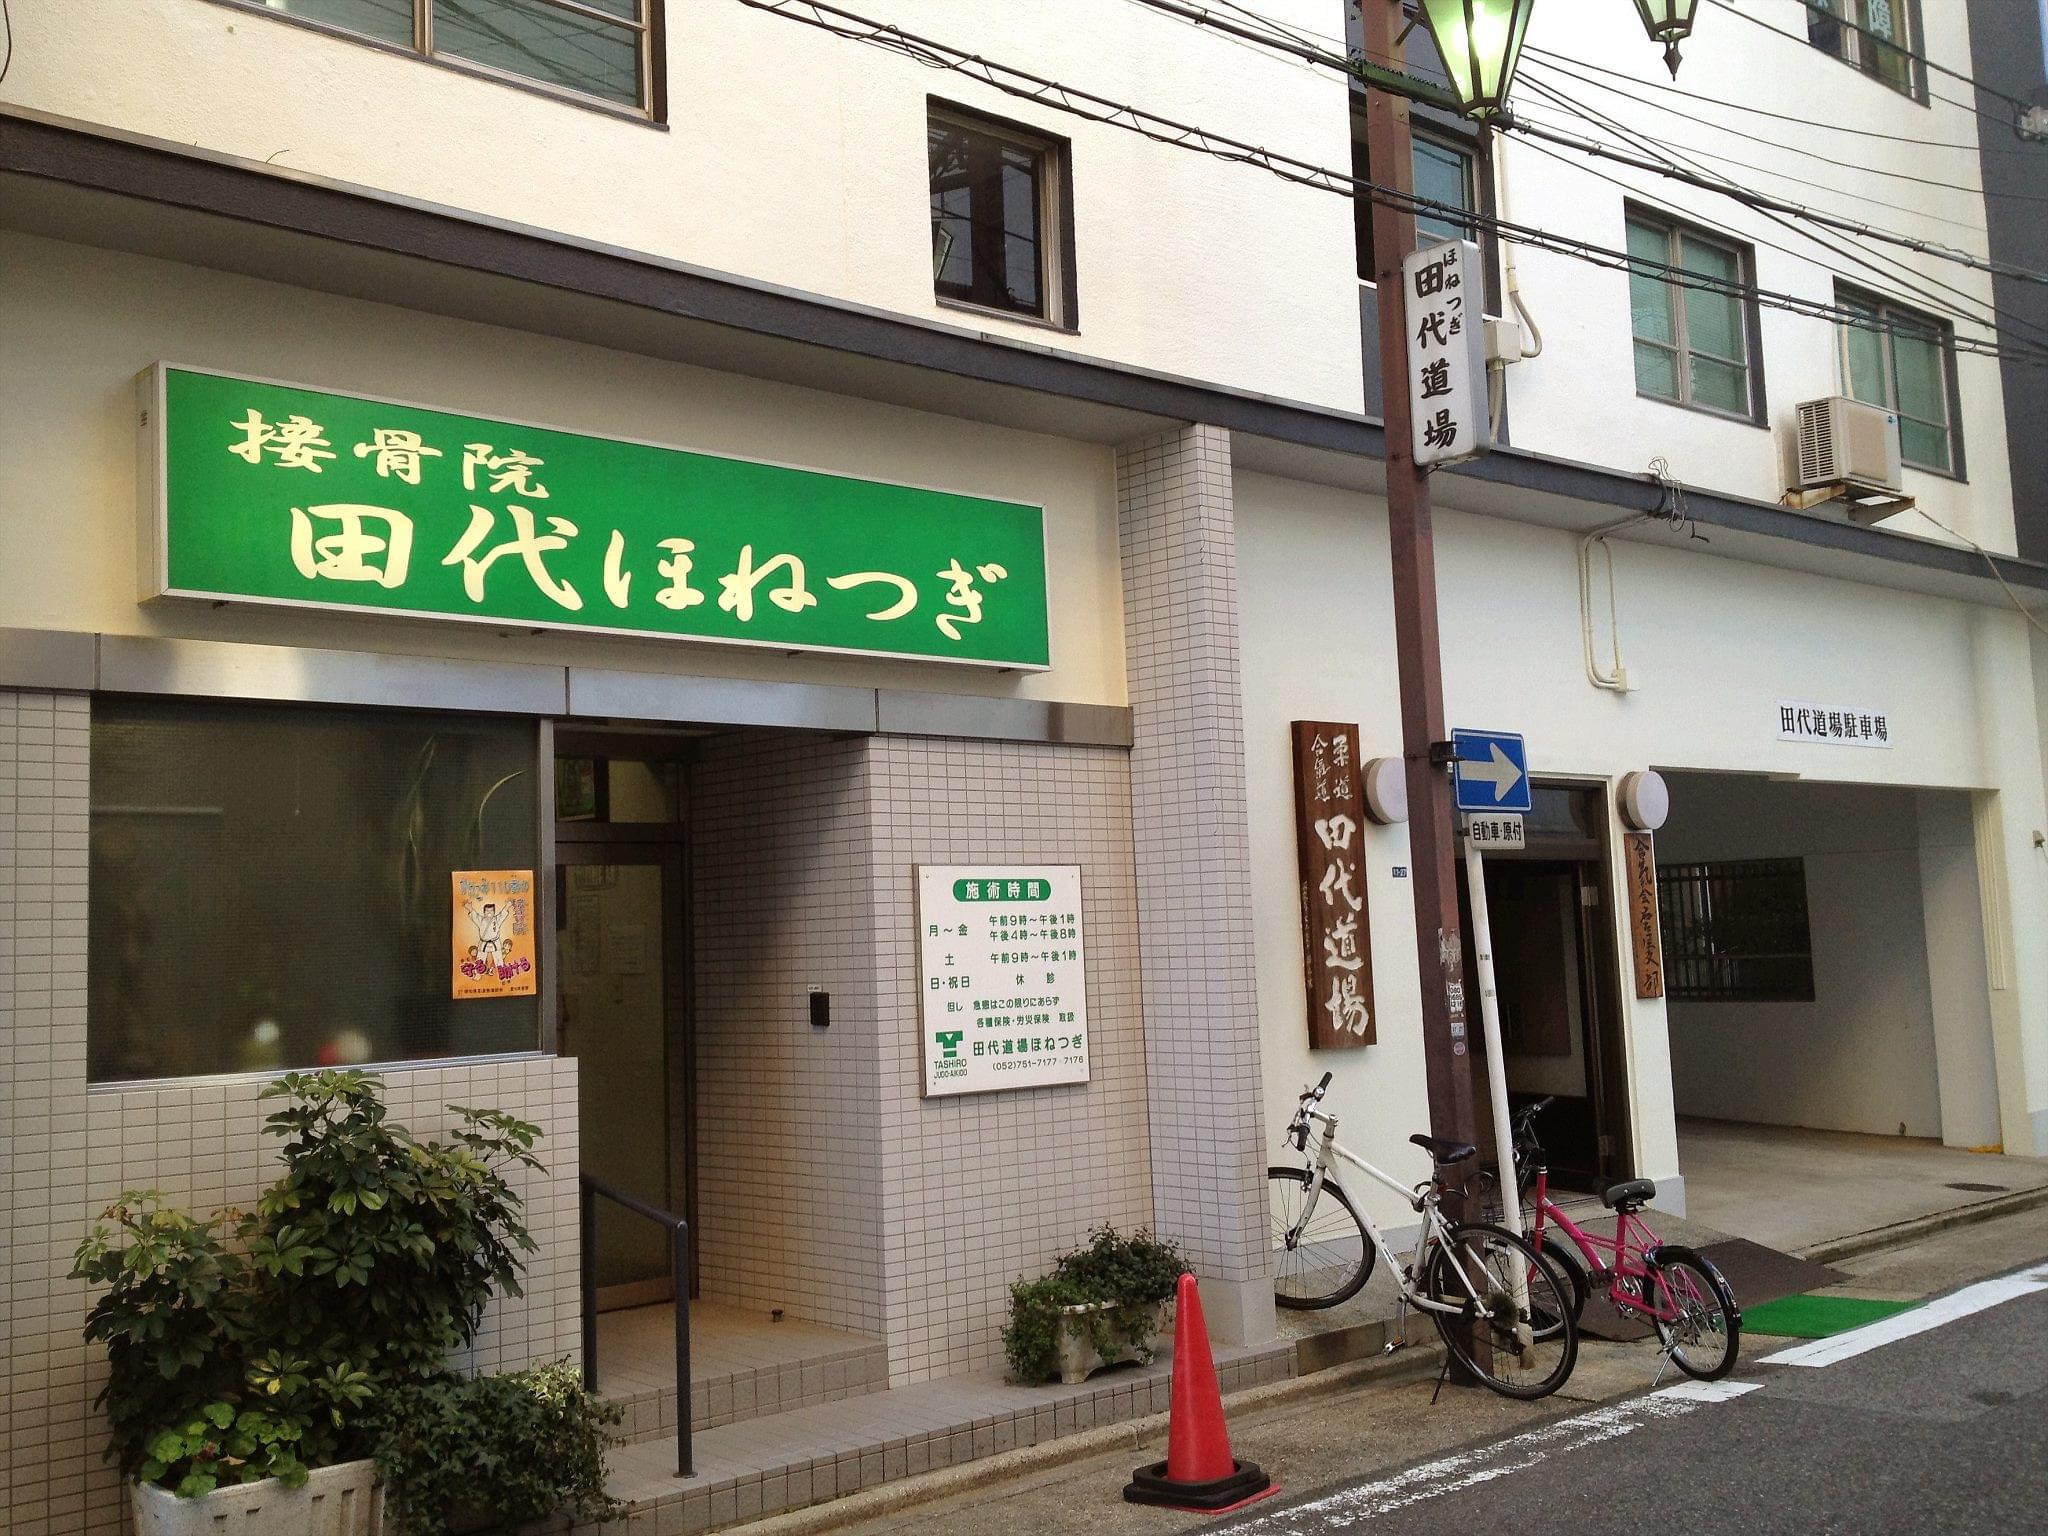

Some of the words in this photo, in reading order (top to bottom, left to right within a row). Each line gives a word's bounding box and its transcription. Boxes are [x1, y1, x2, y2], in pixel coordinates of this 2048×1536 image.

[1443, 248, 1462, 335] ほねつぎ
[1415, 261, 1458, 449] 田代道場
[227, 408, 550, 500] 接骨院
[290, 503, 1009, 641] 田代ほねつぎ
[1780, 705, 1888, 741] 田代道場駐車場
[965, 881, 1041, 899] 施術時間
[1314, 813, 1371, 1037] 田代道場
[945, 953, 955, 966] 土
[934, 1058, 967, 1069] TASHIRO
[973, 1034, 1083, 1056] 田代道場ほねつぎ
